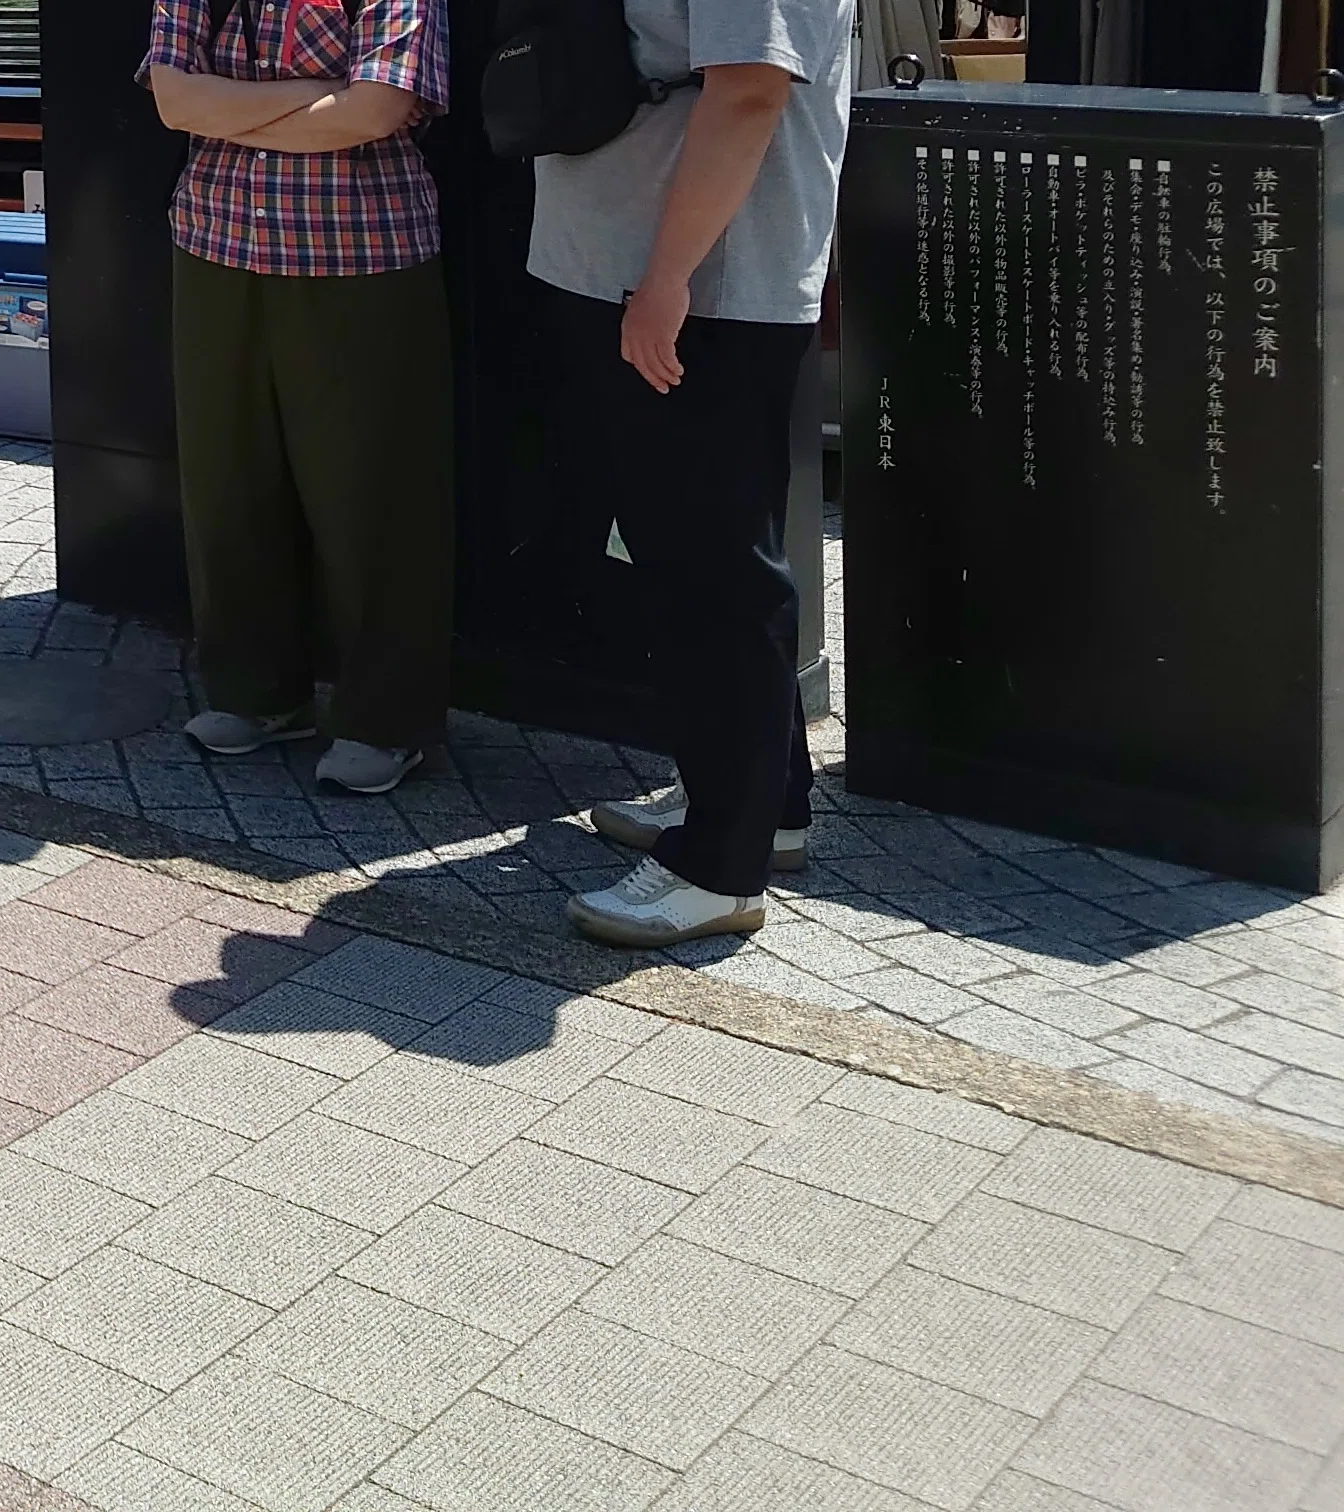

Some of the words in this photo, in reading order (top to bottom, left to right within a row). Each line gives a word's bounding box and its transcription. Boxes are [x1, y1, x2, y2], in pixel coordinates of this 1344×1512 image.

[1250, 166, 1280, 378] 禁止事項のご案内
[878, 377, 896, 471] JR東日本
